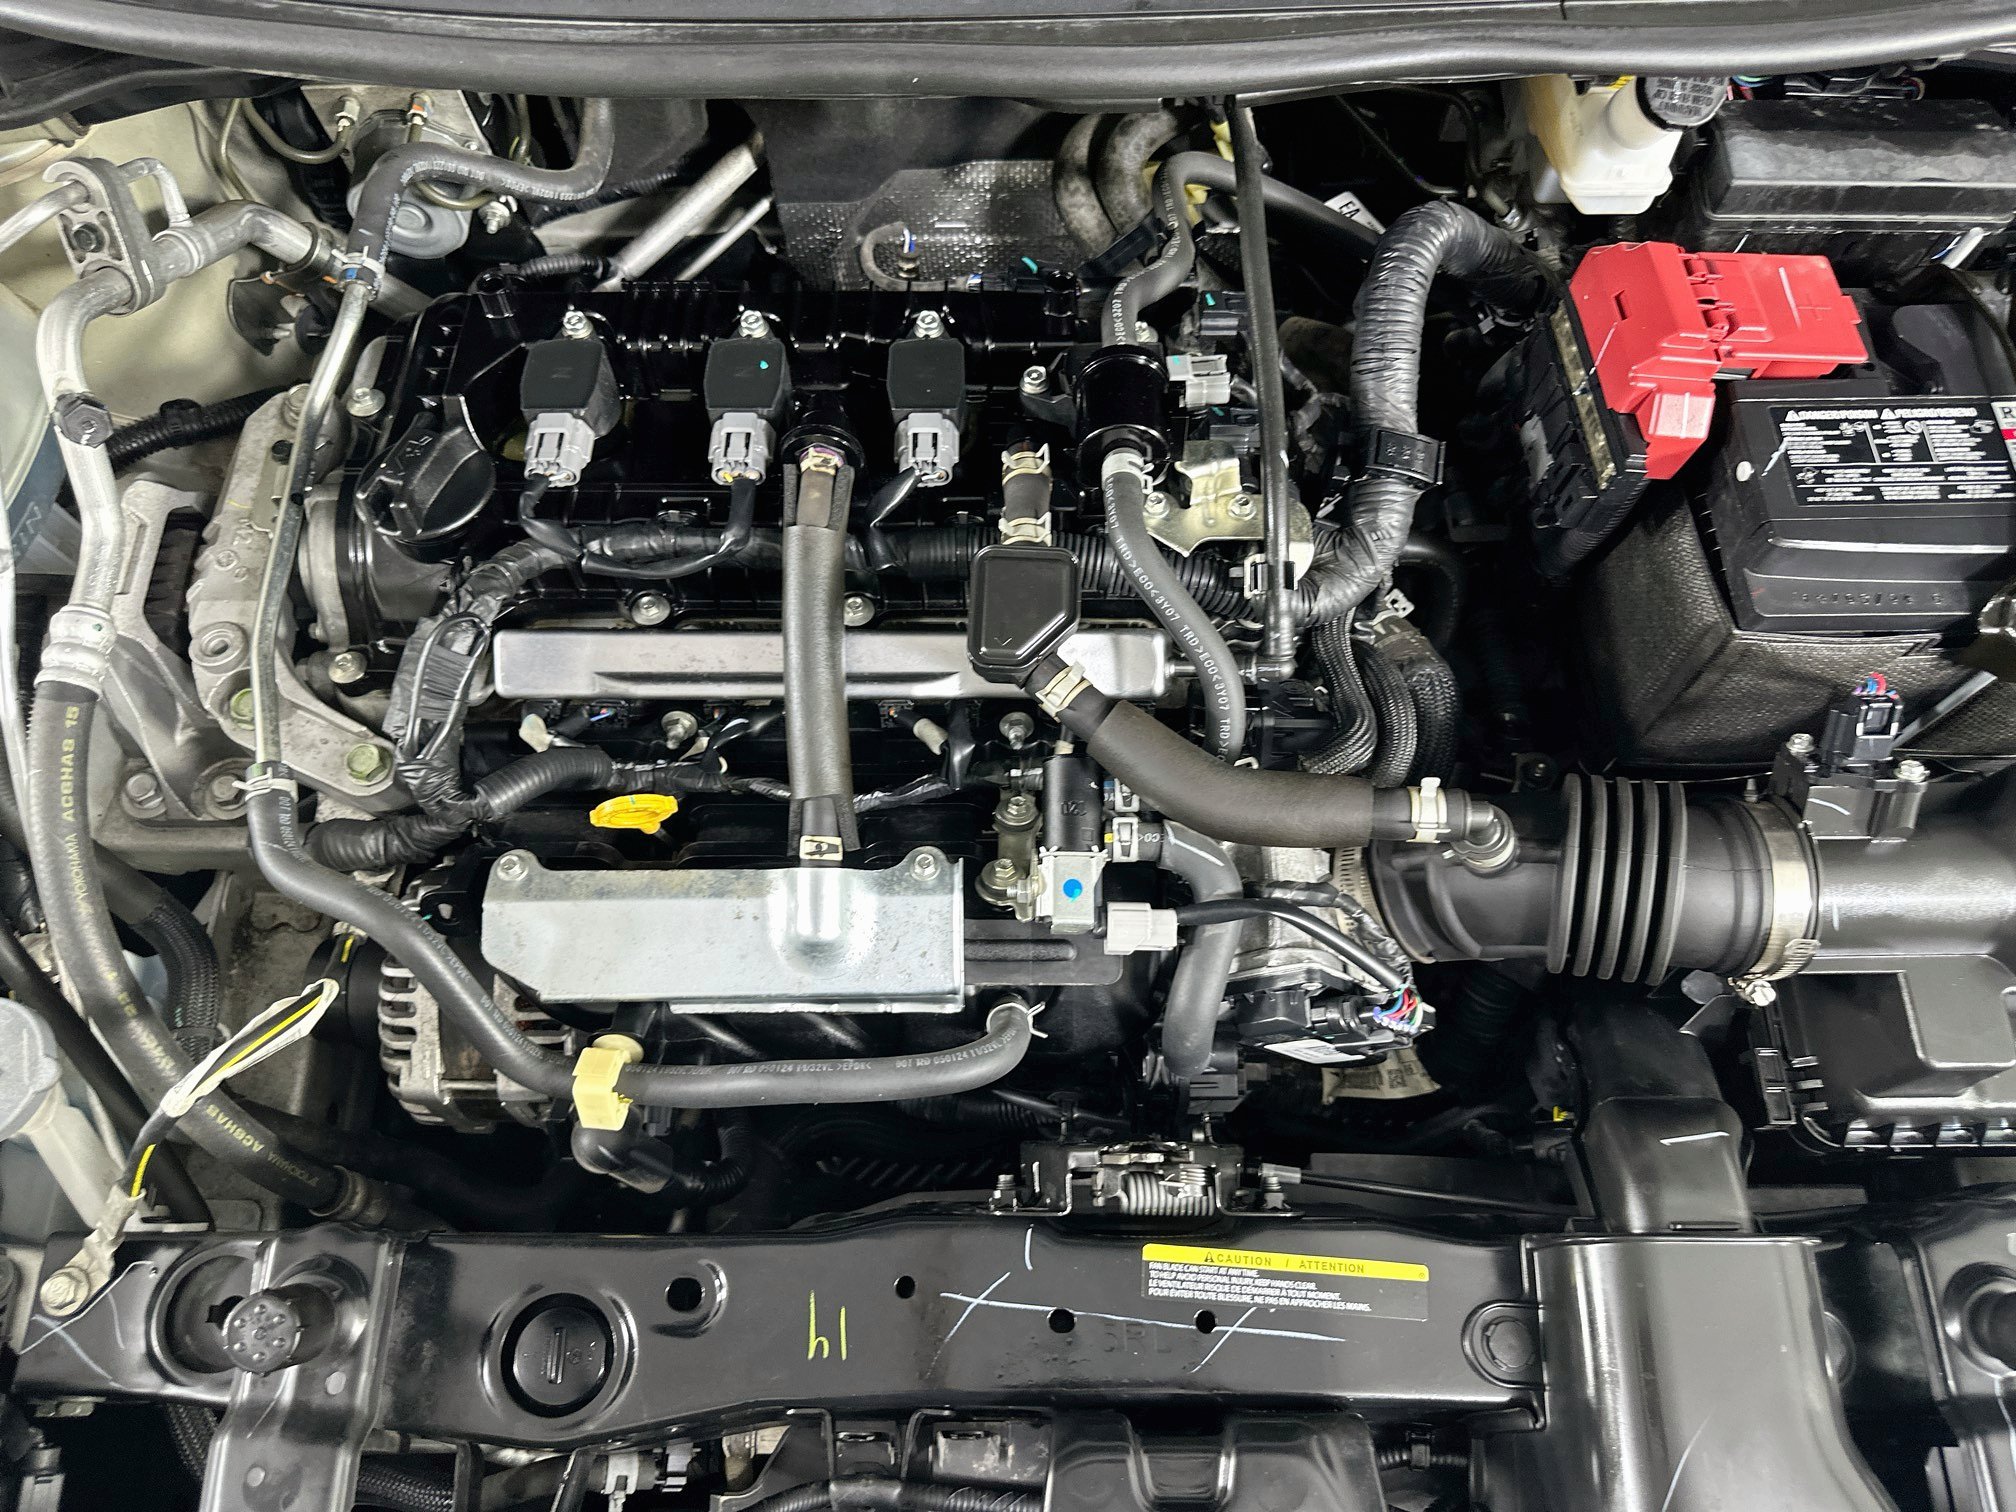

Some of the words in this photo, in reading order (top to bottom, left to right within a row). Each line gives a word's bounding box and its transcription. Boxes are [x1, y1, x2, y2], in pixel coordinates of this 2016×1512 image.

[65, 705, 80, 729] 15
[64, 832, 90, 901] YOKOHAMA
[1163, 1262, 1184, 1272] BLADE
[1183, 1264, 1199, 1273] CAN
[1216, 1253, 1272, 1267] CAUTION
[1299, 1259, 1365, 1274] ATTENTION
[1158, 1270, 1176, 1280] HELP
[1196, 1273, 1230, 1284] PERSONAL
[1147, 1286, 1169, 1297] POUR
[1194, 1290, 1217, 1300] TOUTE
[1289, 1297, 1332, 1309] APPROCHER
[1148, 1278, 1158, 1287] LE
[1157, 1279, 1204, 1290] VENTILATEUR
[1203, 1282, 1231, 1292] RISQUE
[1230, 1284, 1241, 1293] DE
[1286, 1288, 1307, 1298] TOUT
